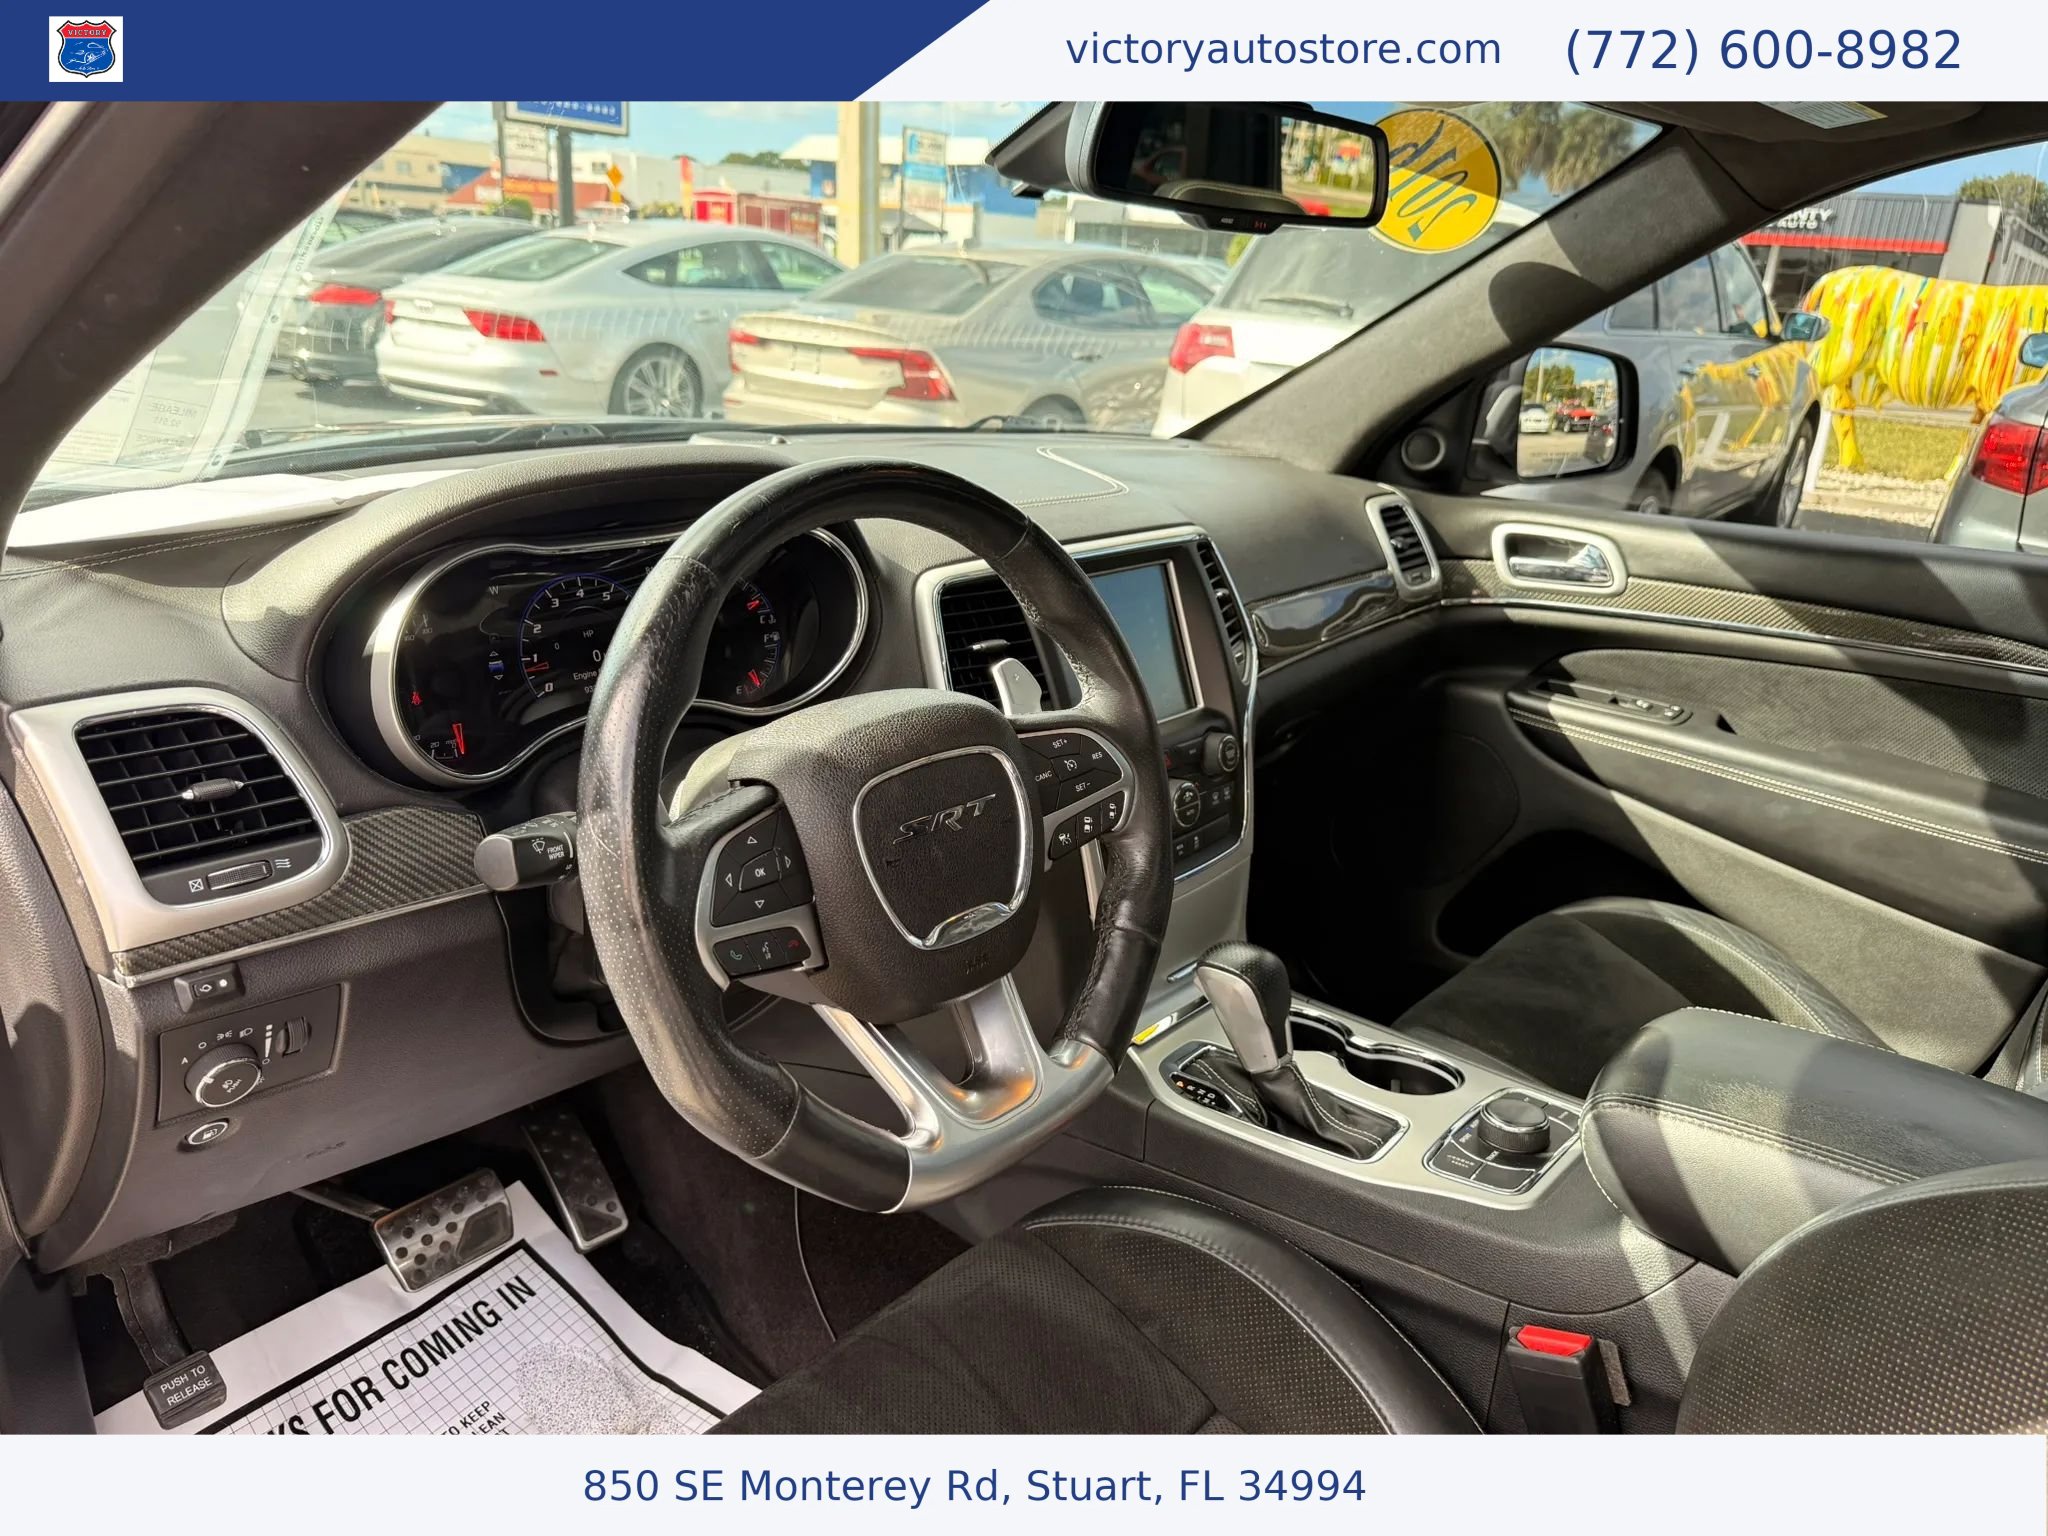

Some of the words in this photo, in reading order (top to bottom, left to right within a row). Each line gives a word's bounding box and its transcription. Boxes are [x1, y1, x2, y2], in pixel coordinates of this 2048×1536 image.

[488, 585, 499, 595] W
[576, 589, 585, 598] 4
[602, 592, 611, 600] 5
[551, 599, 559, 608] 3
[533, 624, 542, 633] 2
[583, 630, 594, 639] HP
[532, 654, 538, 662] 1
[592, 650, 601, 662] 0
[573, 669, 597, 681] Engine
[545, 682, 554, 692] 0
[1092, 751, 1103, 760] RES
[1035, 770, 1053, 782] CANC
[892, 793, 996, 845] SRT
[547, 844, 564, 854] FRONT
[548, 851, 565, 861] WIPER
[754, 868, 766, 878] OK
[181, 1056, 189, 1065] A
[226, 1078, 242, 1094] PUSH
[312, 1374, 386, 1434] FOR
[381, 1299, 503, 1391] COMING
[496, 1275, 538, 1311] IN
[160, 1371, 189, 1394] PUSH
[190, 1363, 206, 1377] TO
[166, 1377, 213, 1408] RELEASE
[459, 1400, 491, 1428] KEEP
